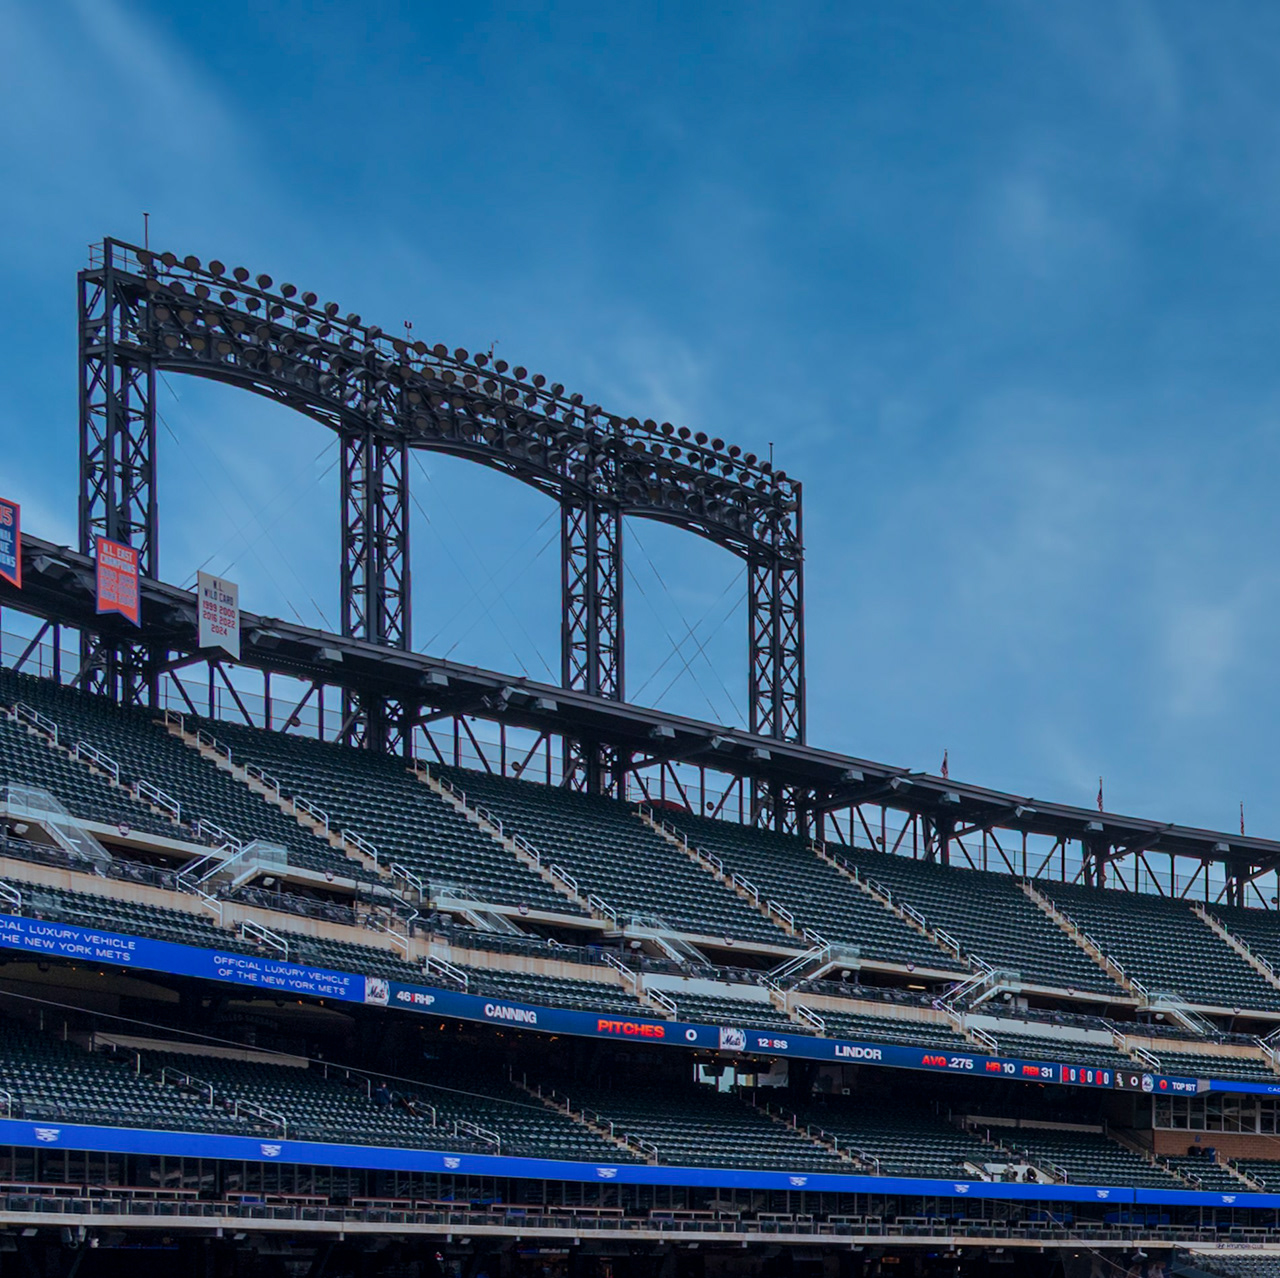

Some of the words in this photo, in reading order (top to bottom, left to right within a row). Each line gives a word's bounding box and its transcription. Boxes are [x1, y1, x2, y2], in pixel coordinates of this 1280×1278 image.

[204, 588, 217, 600] WILD
[219, 593, 234, 606] CARD
[219, 605, 236, 618] 2000
[211, 624, 228, 636] 2024
[219, 615, 236, 629] 2022
[29, 925, 80, 940] LUXURY
[83, 934, 136, 950] VEHICLE
[24, 937, 55, 949] NEW
[59, 942, 92, 955] YORK
[95, 948, 131, 961] METS
[213, 955, 261, 971] OFFICIAL
[265, 964, 305, 978] LUXURY
[308, 972, 350, 986] VEHICLE
[218, 968, 233, 977] OF
[237, 970, 257, 982] THE
[261, 974, 286, 986] NEW
[288, 980, 315, 991] YORK
[318, 984, 346, 996] METS
[484, 1003, 537, 1024] CANNING
[597, 1018, 665, 1038] PITCHES
[834, 1045, 882, 1060] LINDOR
[922, 1055, 947, 1067] AVG
[948, 1057, 974, 1069] .275
[985, 1061, 1001, 1072] HR
[1003, 1063, 1015, 1074] 10
[1022, 1065, 1039, 1077] RBI
[1041, 1067, 1053, 1078] 31
[1172, 1081, 1185, 1091] TOP
